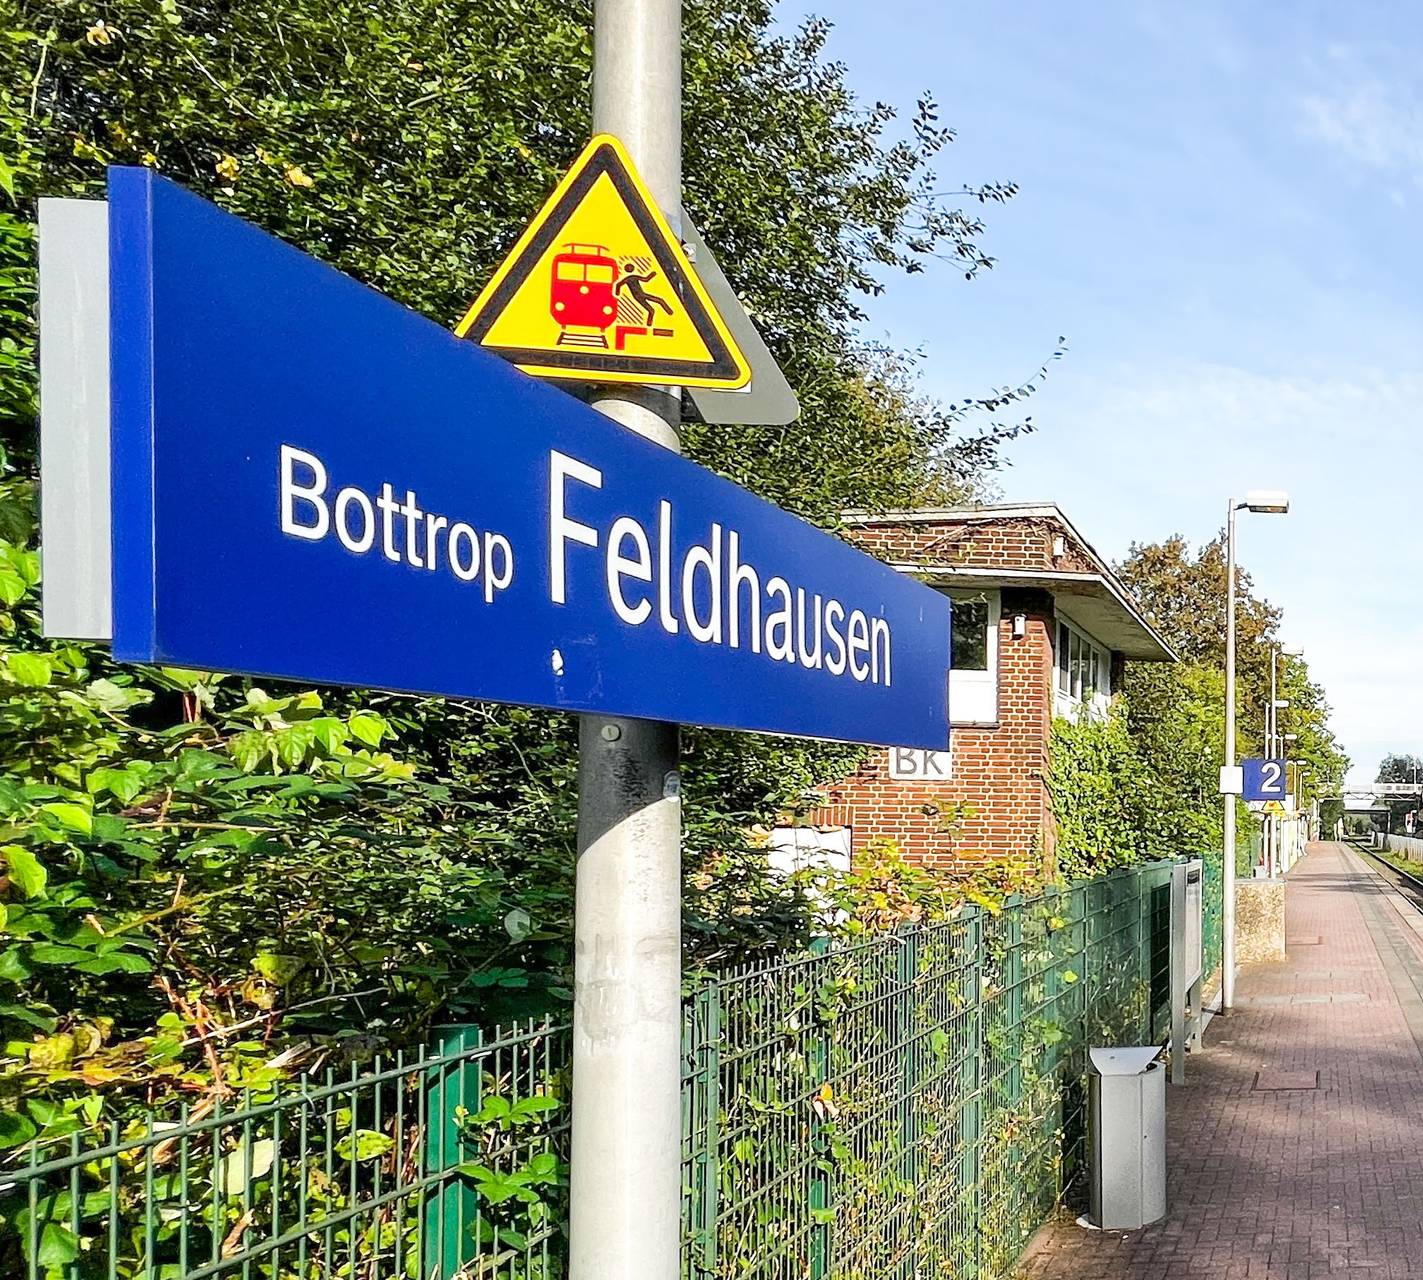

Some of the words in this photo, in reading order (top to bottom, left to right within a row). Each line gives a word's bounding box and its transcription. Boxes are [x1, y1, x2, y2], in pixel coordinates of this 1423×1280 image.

[280, 444, 513, 602] Bottrop
[551, 450, 892, 687] Feldhausen
[898, 746, 944, 775] BK
[1260, 762, 1281, 792] 2
